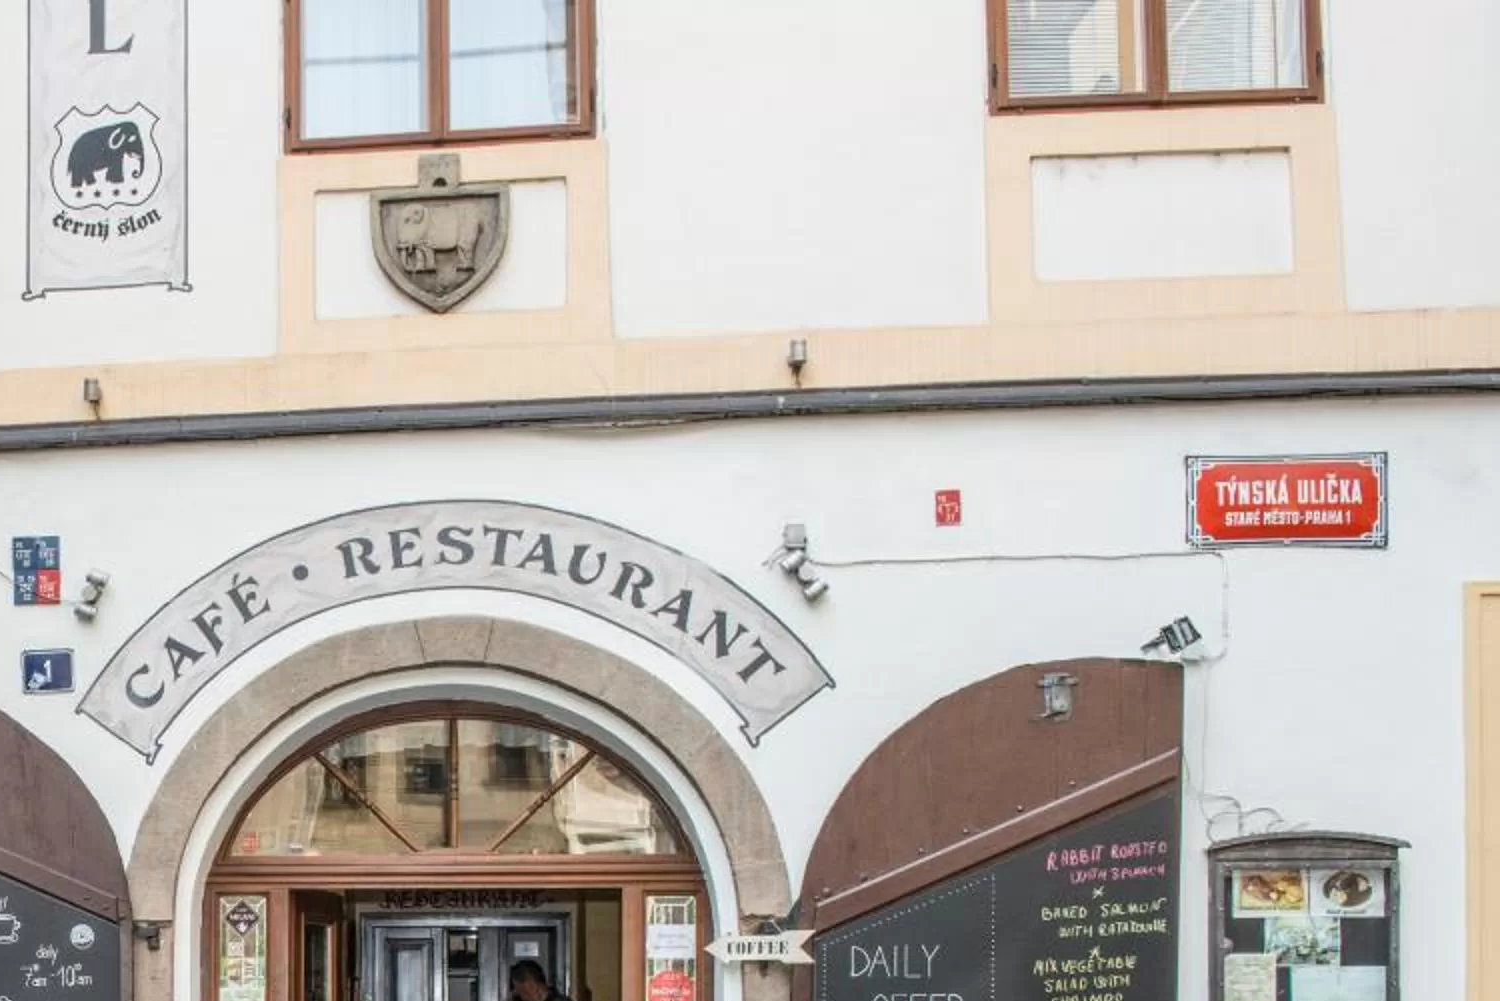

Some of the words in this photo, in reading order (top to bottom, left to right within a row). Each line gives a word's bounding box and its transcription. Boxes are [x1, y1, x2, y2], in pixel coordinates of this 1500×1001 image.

[116, 207, 164, 237] slon
[1215, 473, 1290, 507] TÝNSKÁ
[1296, 473, 1363, 505] ULIČKA
[1224, 509, 1261, 526] STARÉ
[124, 572, 272, 708] CAFÉ
[341, 524, 787, 684] RESTAURANT
[1047, 845, 1104, 871] RABBIT
[727, 941, 789, 956] COFFEE
[850, 944, 941, 979] DAILY
[1044, 978, 1087, 993] SALAD
